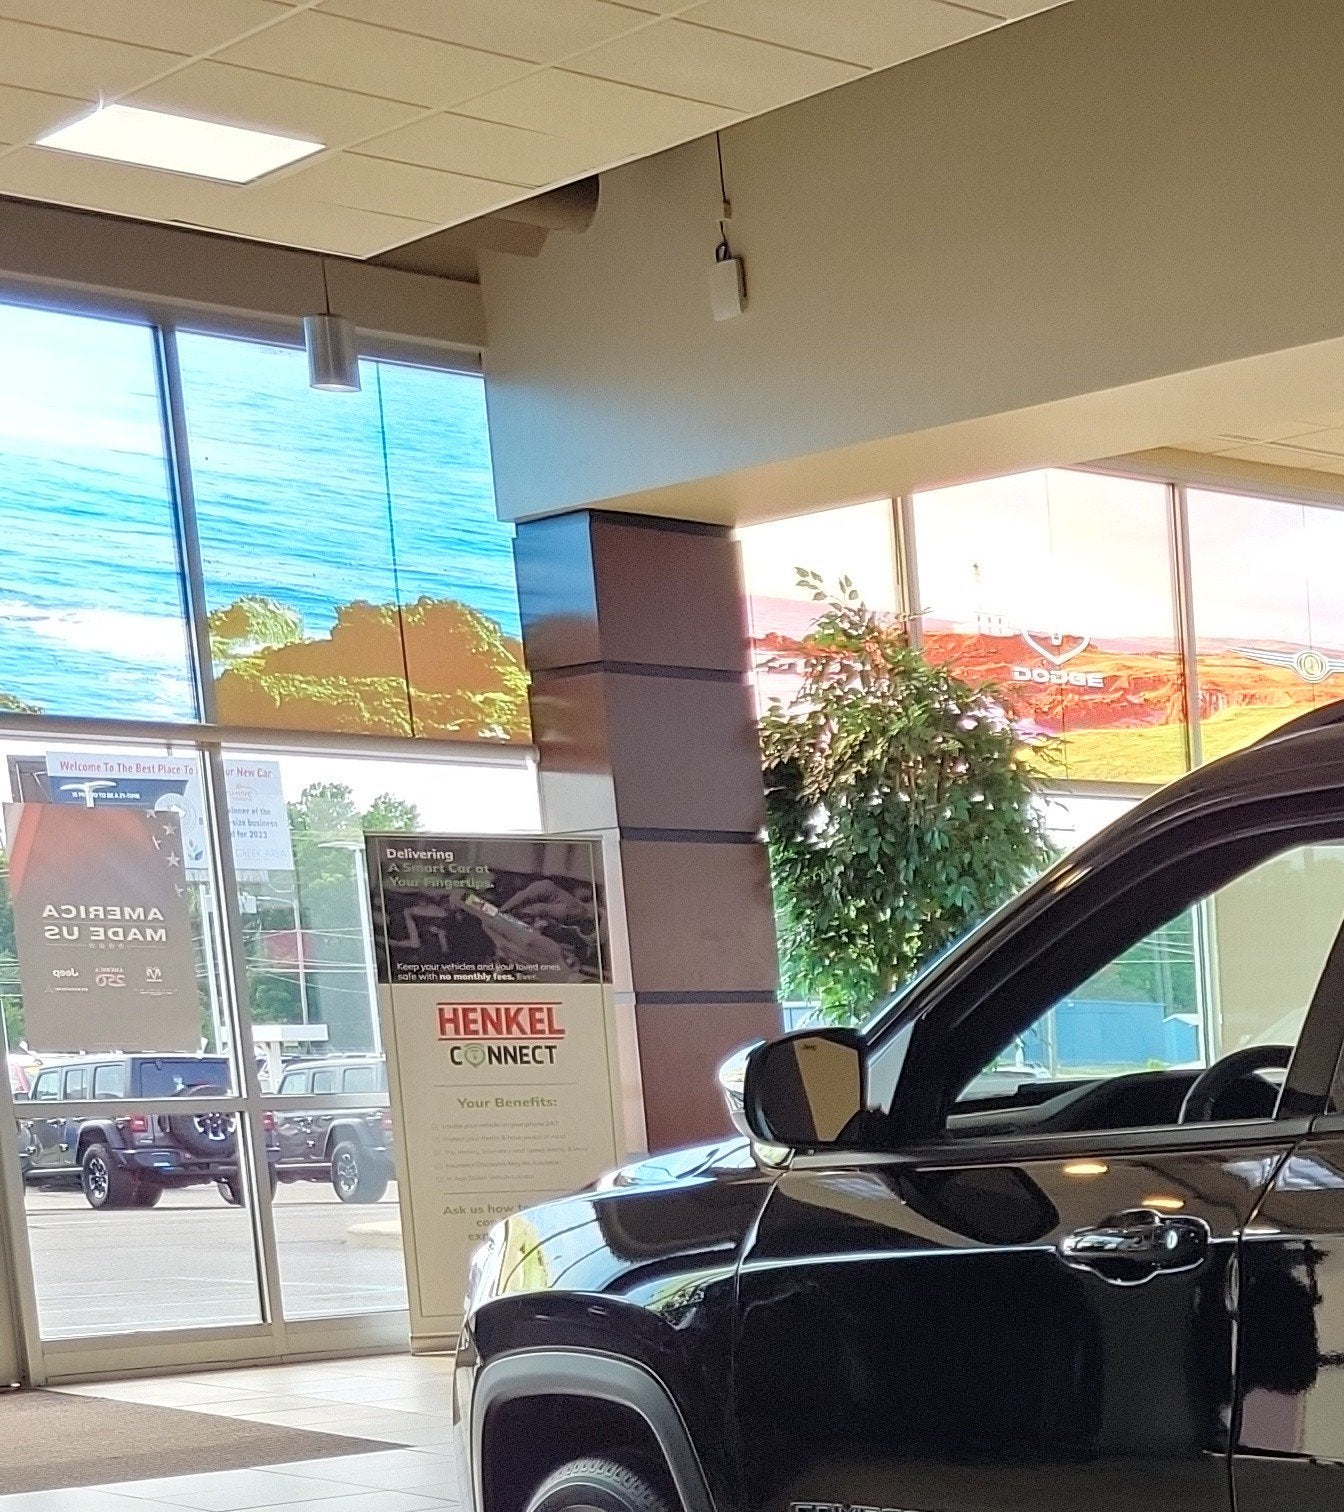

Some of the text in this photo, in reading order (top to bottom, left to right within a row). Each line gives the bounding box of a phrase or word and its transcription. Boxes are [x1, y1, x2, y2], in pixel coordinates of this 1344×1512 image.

[1013, 666, 1104, 688] DODGE
[60, 760, 101, 772] Welcome
[104, 762, 114, 772] To
[117, 763, 132, 773] The
[135, 763, 155, 774] Best
[158, 764, 181, 774] Place
[184, 765, 193, 775] To
[237, 767, 254, 777] New
[257, 768, 272, 778] Car
[260, 806, 271, 815] the
[386, 848, 454, 862] Delivering
[388, 863, 489, 874] A Smart Car at
[389, 877, 419, 887] Your
[396, 963, 419, 972] Keep
[420, 964, 441, 972] your
[441, 963, 475, 971] vehicles
[477, 963, 494, 971] and
[516, 963, 538, 971] loved
[540, 963, 561, 971] ones
[398, 973, 417, 981] safe
[439, 973, 454, 981] no
[455, 973, 491, 982] monthly
[492, 973, 515, 981] fees.
[438, 1007, 566, 1036] HENKEL
[450, 1044, 557, 1067] CONNECT
[457, 1096, 558, 1109] Your Benefits:
[443, 1205, 467, 1216] Ask
[470, 1206, 484, 1214] us
[488, 1204, 514, 1214] how
